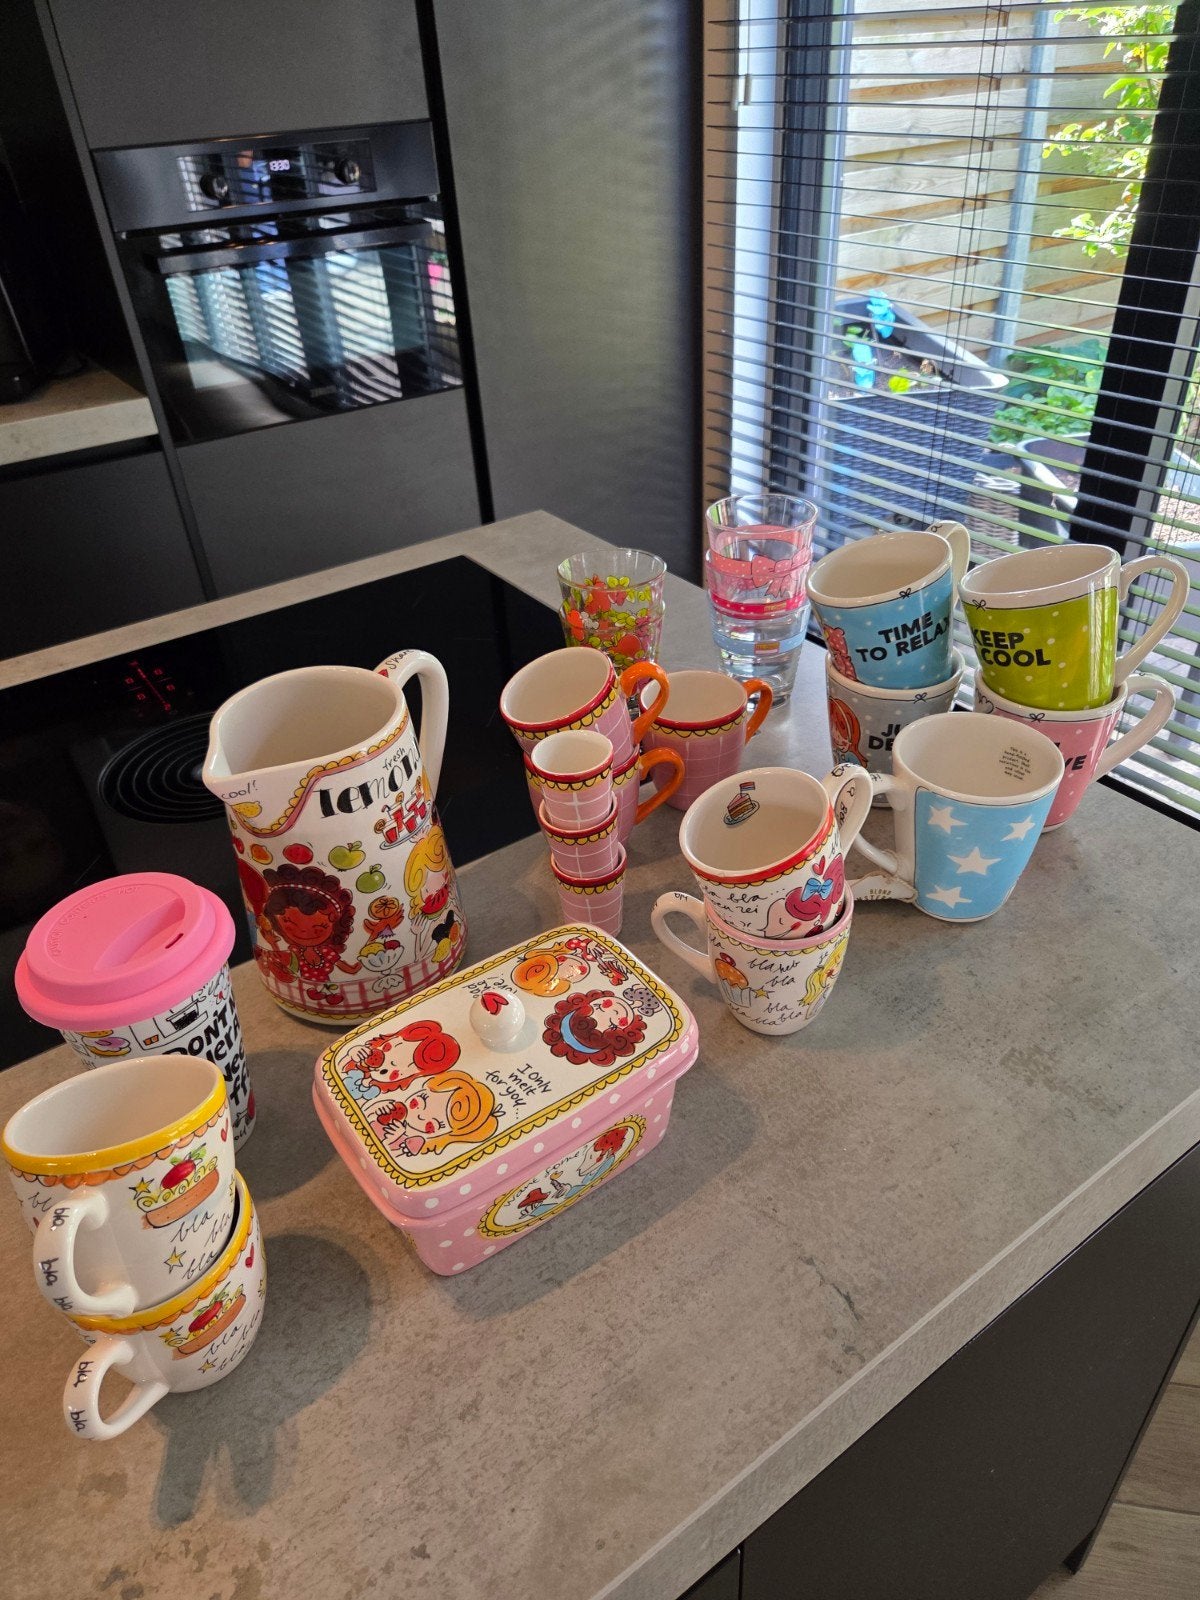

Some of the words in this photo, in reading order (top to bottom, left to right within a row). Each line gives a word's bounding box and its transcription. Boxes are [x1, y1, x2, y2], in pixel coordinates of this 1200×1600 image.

[878, 611, 934, 644] TIME
[972, 629, 1025, 650] KEEP
[855, 647, 888, 662] TO
[981, 648, 1052, 667] COOL
[383, 747, 406, 771] fresh
[746, 958, 774, 972] bla
[764, 975, 797, 988] bla
[763, 1002, 794, 1014] bla
[777, 1011, 803, 1023] bla
[485, 1070, 508, 1086] for
[516, 1062, 533, 1075] I
[508, 1072, 537, 1097] melt
[170, 1210, 214, 1243] bla
[203, 1212, 232, 1248] bla
[41, 1256, 60, 1287] bla
[181, 1250, 218, 1281] bla
[203, 1322, 243, 1359] bla
[214, 1344, 246, 1373] bla
[73, 1360, 95, 1389] bla
[69, 1409, 88, 1433] bla
